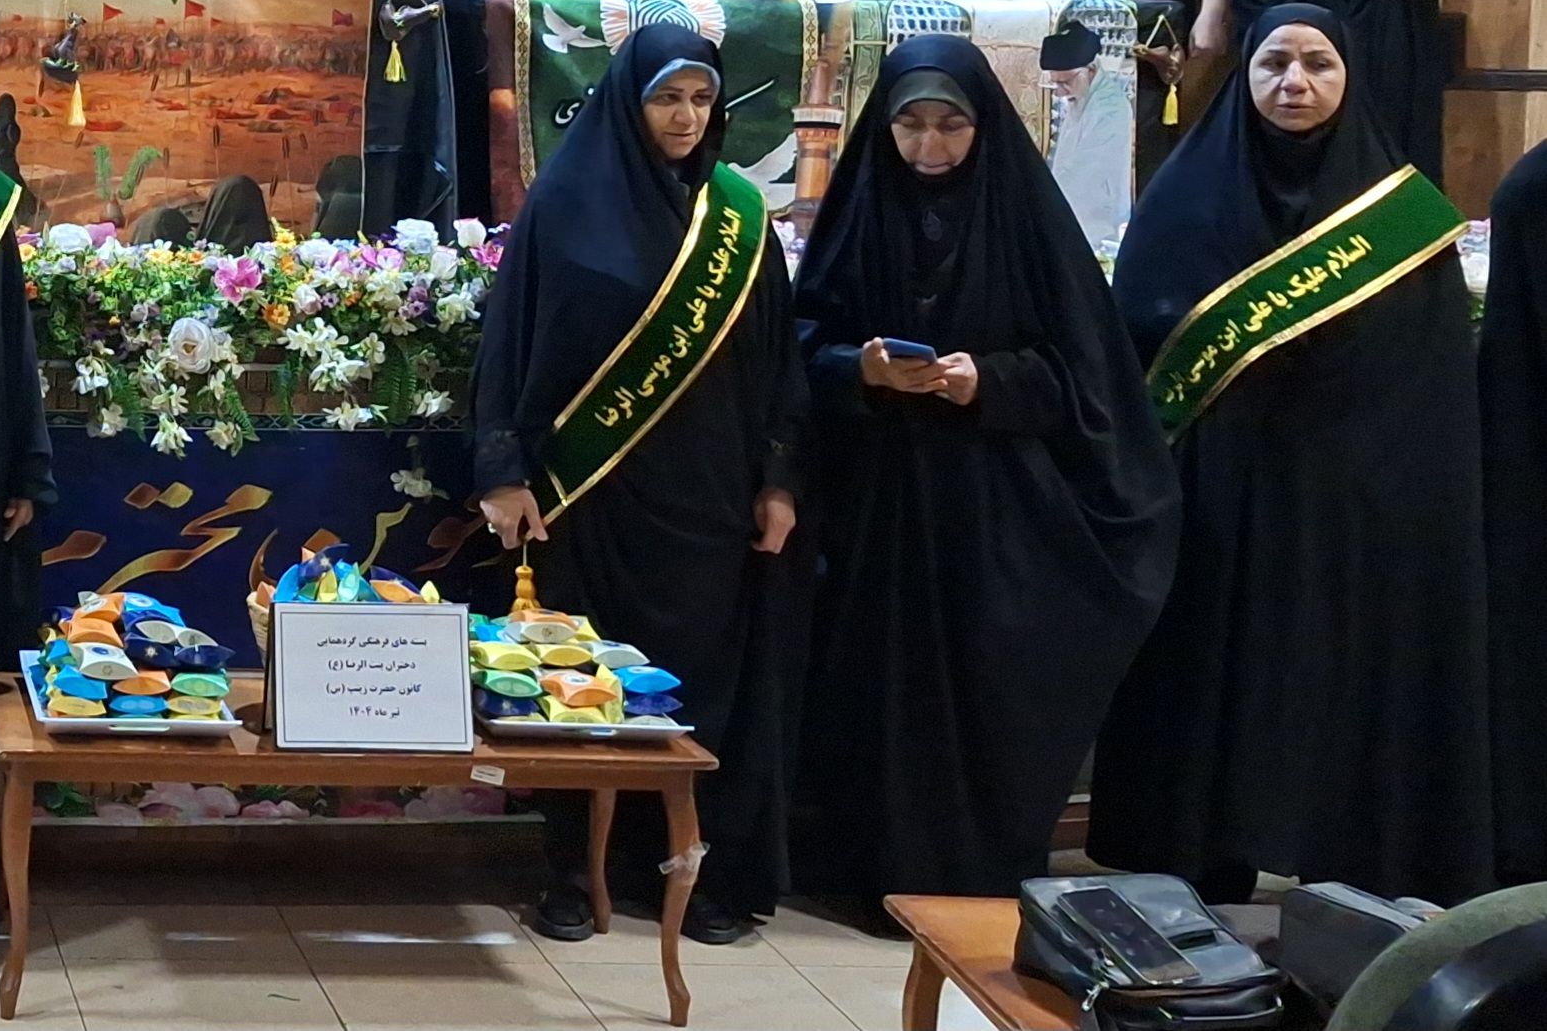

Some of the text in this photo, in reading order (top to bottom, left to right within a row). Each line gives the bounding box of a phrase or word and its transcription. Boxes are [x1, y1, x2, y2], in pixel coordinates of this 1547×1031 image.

[1326, 234, 1372, 280] السلام
[1287, 265, 1328, 298] علیک
[1266, 290, 1293, 310] یا
[595, 206, 741, 428] السلام علیک یا علی ابن موسی الرضا
[1244, 300, 1272, 333] علی
[1218, 318, 1241, 352] ابن
[1189, 344, 1218, 384] موسی
[317, 636, 427, 648] بسته های فرهنگی گردهمایی
[328, 659, 416, 672] دختران بنت الرضا (ع)
[326, 682, 421, 696] کانون حضرت زینب (س)
[375, 707, 387, 717] ماه
[390, 706, 400, 718] تیر
